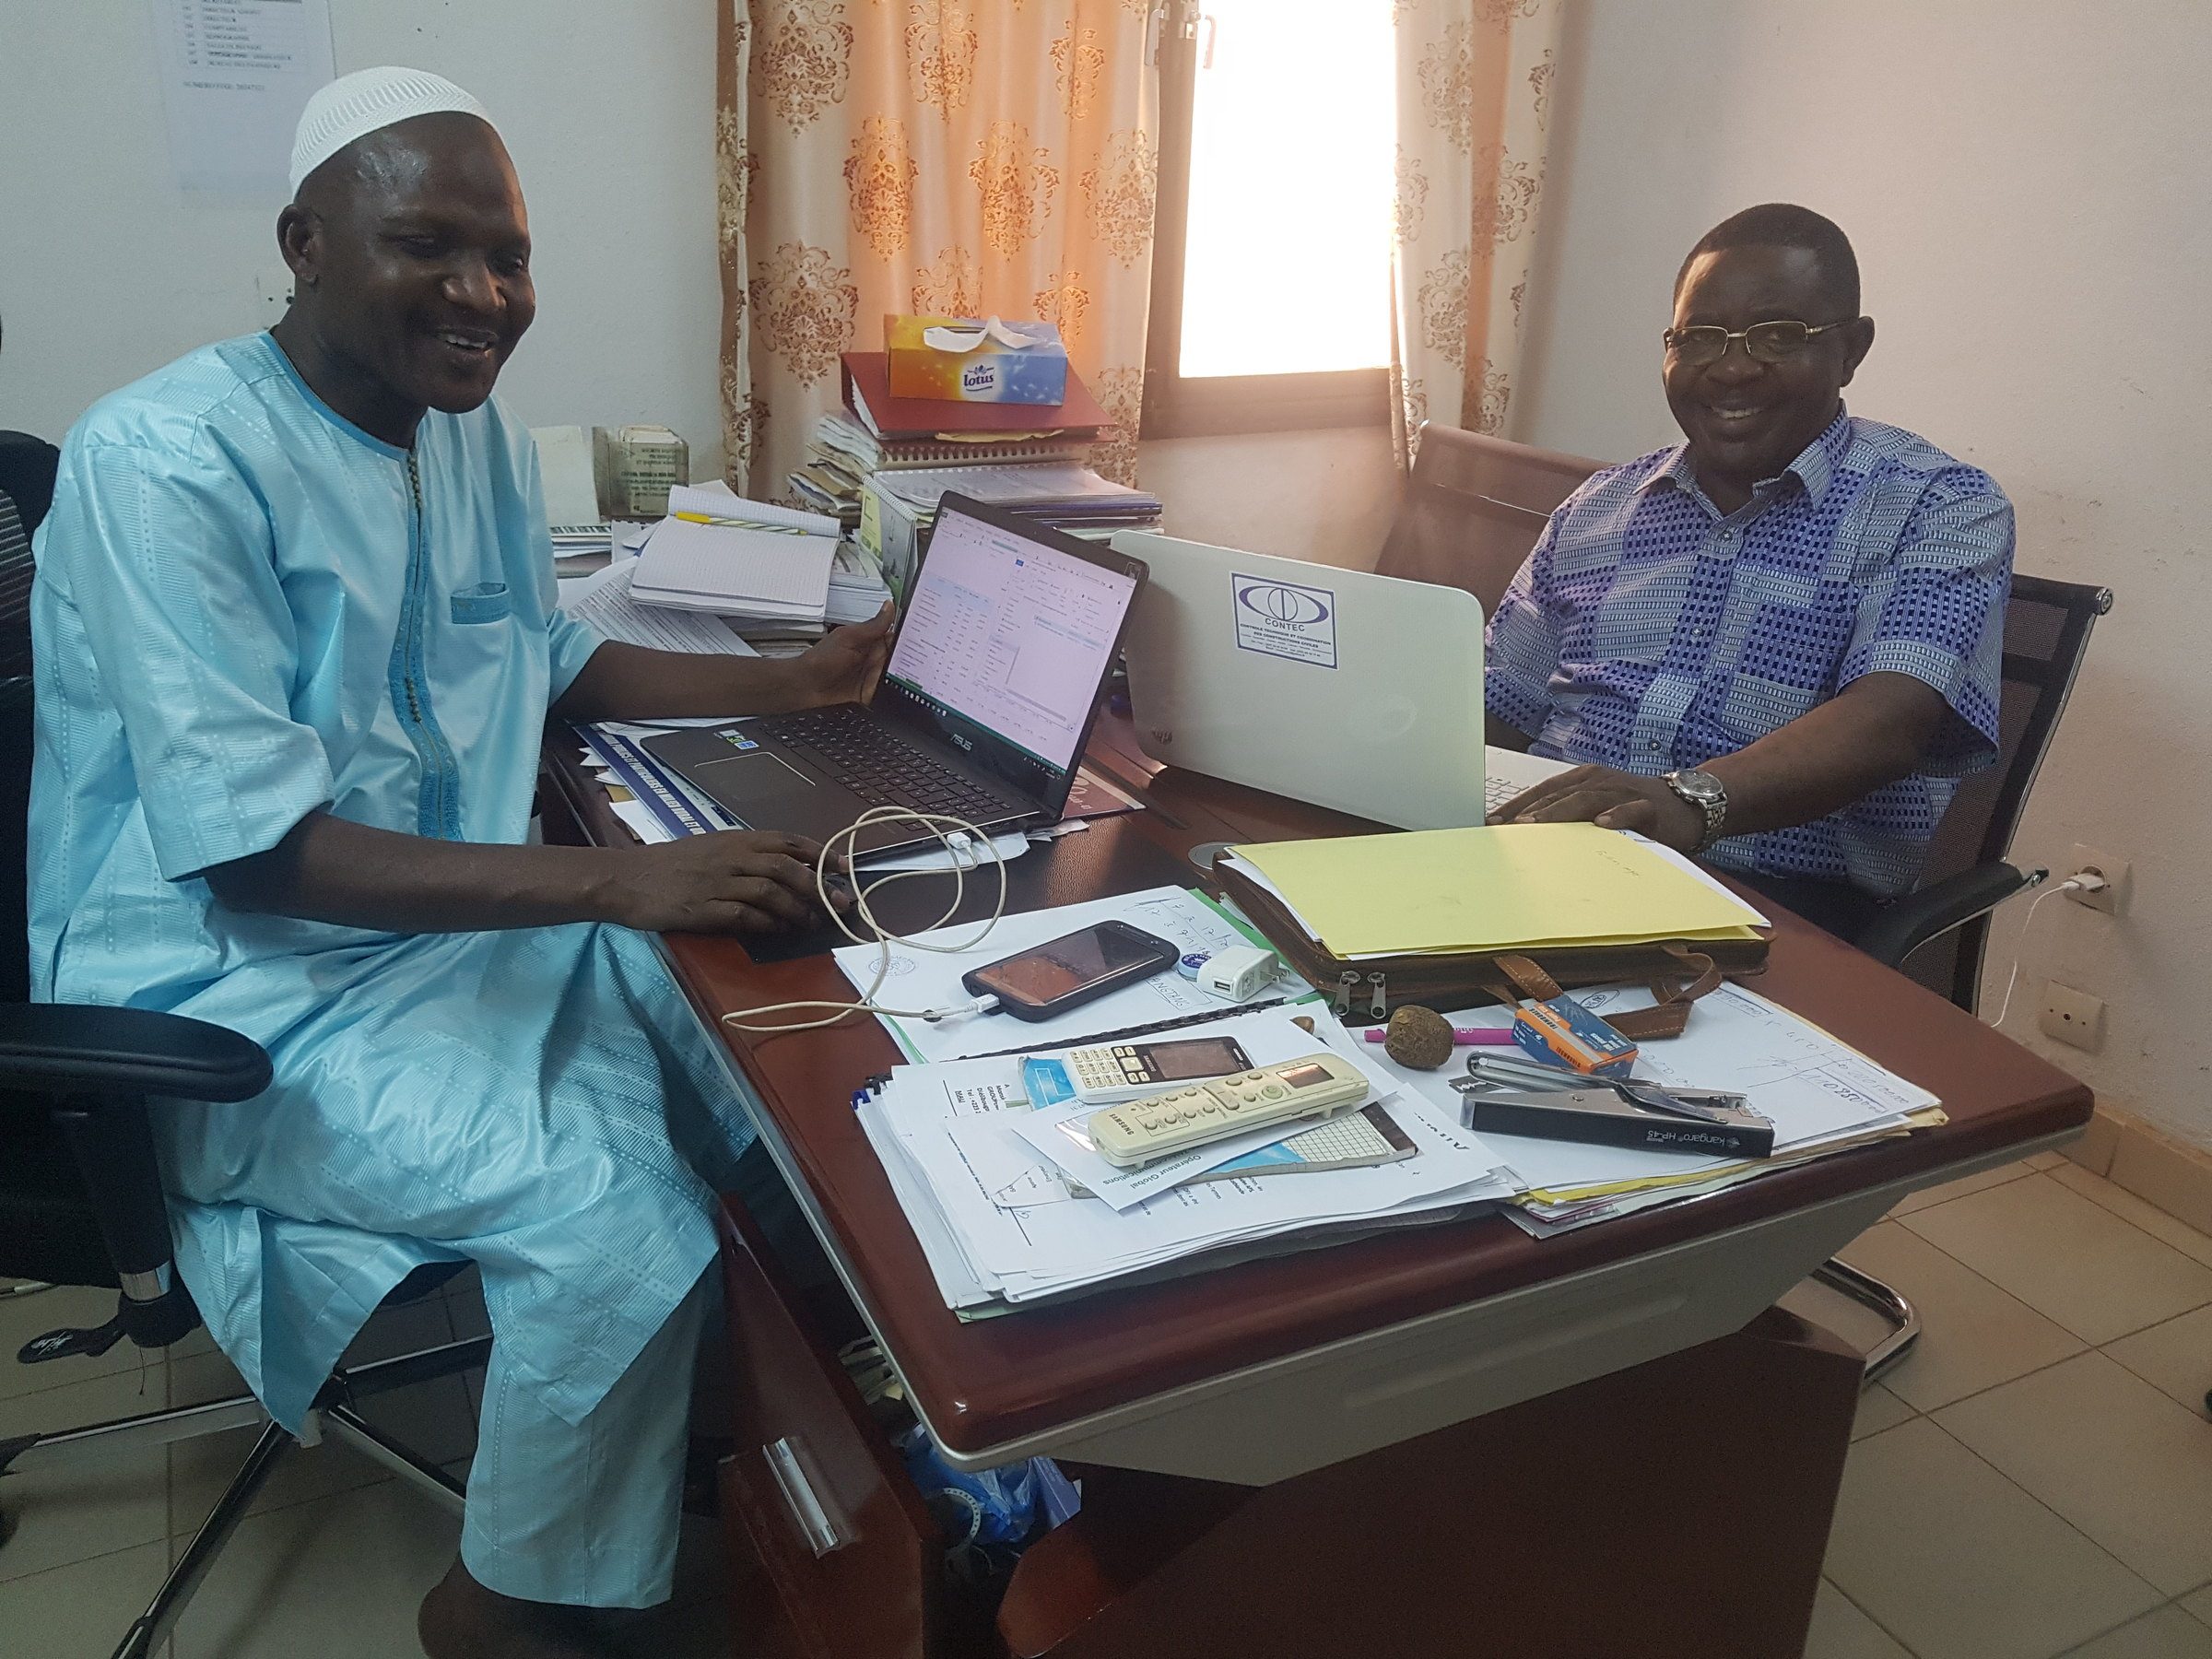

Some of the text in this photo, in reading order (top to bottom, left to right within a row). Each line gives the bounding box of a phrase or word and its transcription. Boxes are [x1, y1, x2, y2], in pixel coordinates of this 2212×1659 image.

[963, 374, 994, 387] lotus
[1265, 618, 1305, 631] CONTEC
[1263, 633, 1300, 644] CONSTRUCTIONS
[950, 733, 973, 751] ASUS
[1109, 1113, 1135, 1135] SAMSUNG
[1647, 1130, 1677, 1141] HP-45
[1130, 1154, 1202, 1190] Opérateur Global
